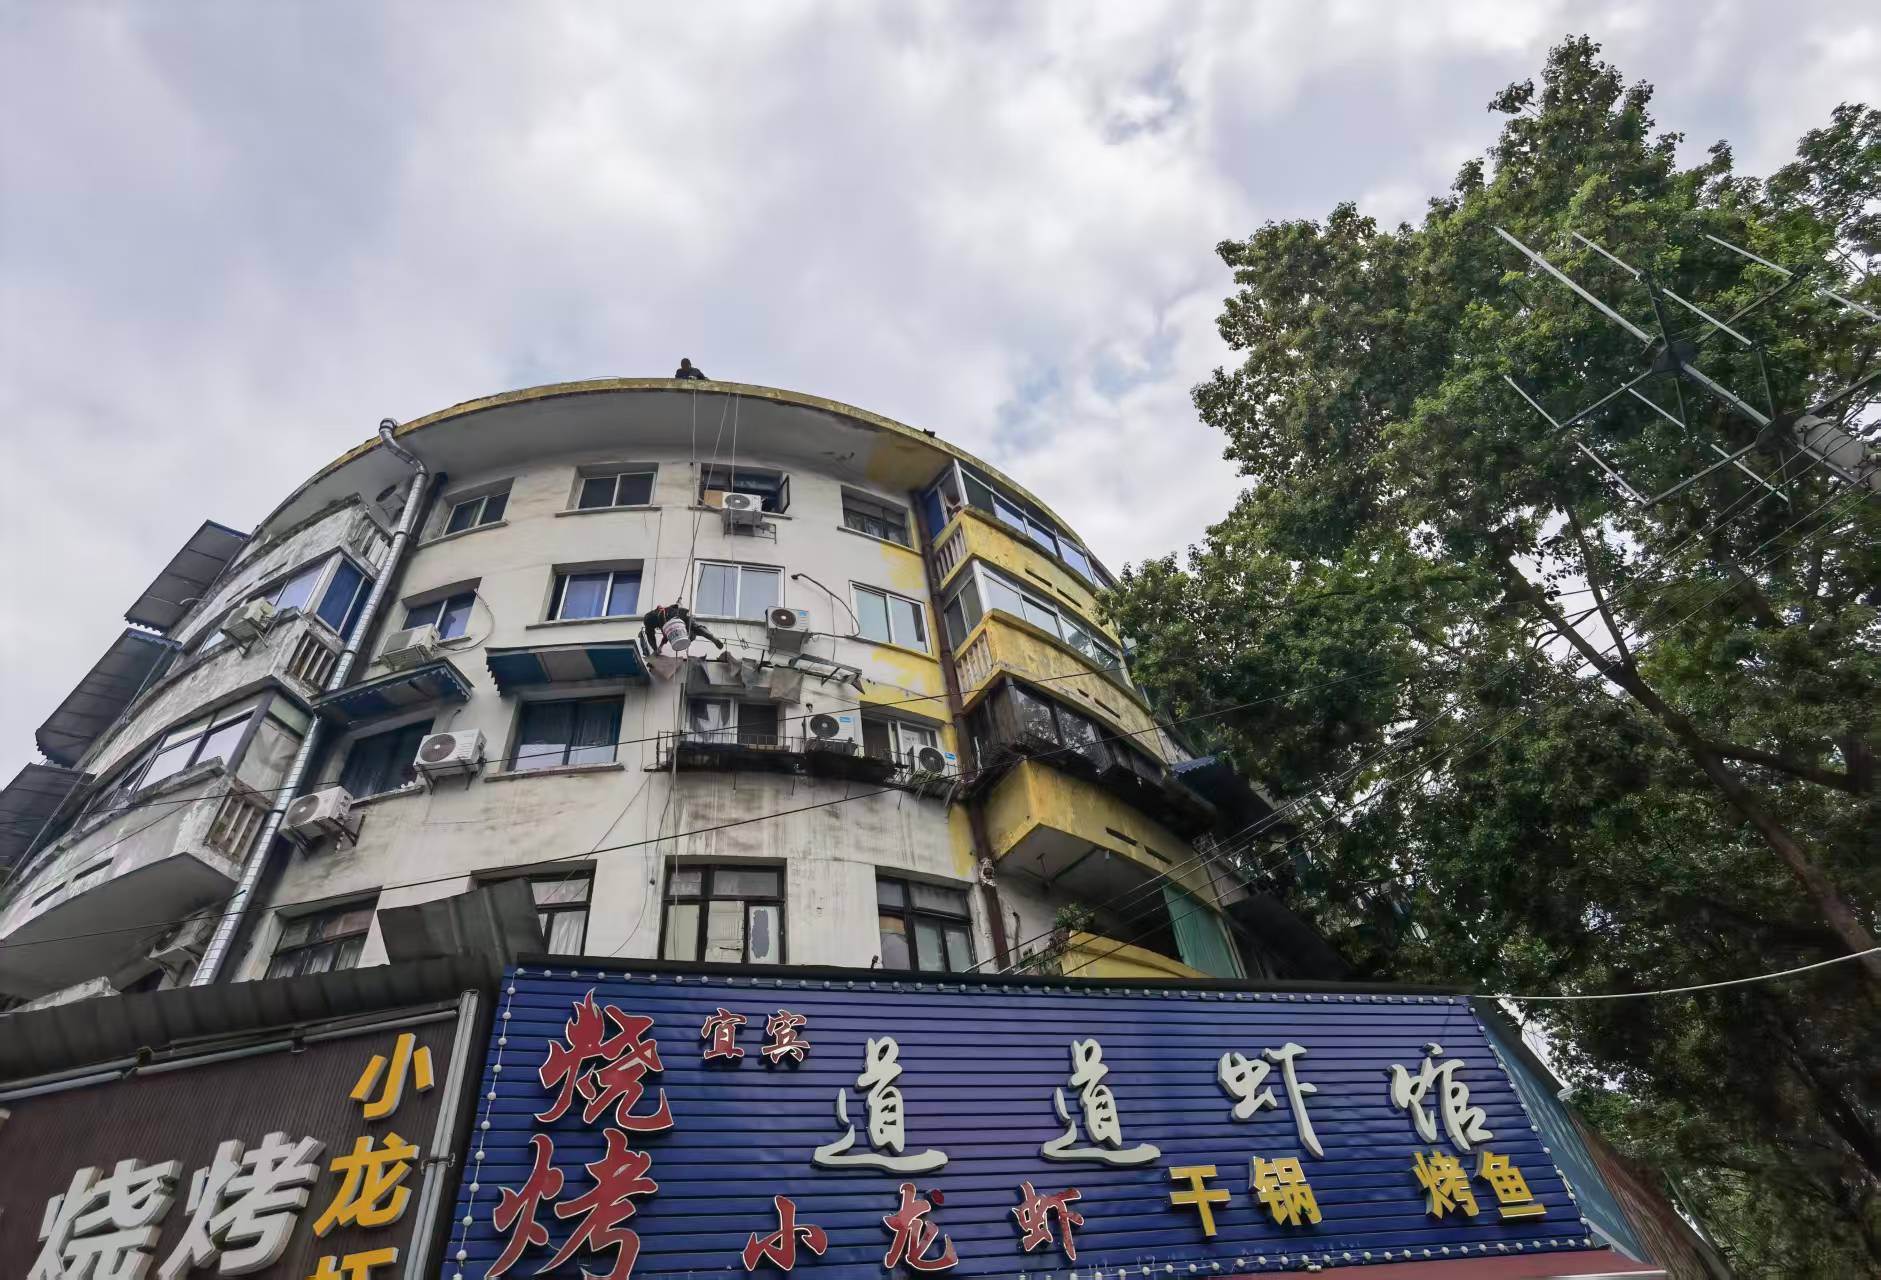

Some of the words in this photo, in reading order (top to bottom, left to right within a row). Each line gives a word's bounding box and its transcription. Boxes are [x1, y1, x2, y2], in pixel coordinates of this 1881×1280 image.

[700, 1006, 811, 1065] 宜宾
[484, 987, 674, 1280] 烧烤
[813, 1036, 1494, 1173] 道道虾馆
[743, 1180, 1085, 1272] 小龙虾
[1168, 1155, 1323, 1237] 干锅
[1409, 1150, 1548, 1219] 烤鱼
